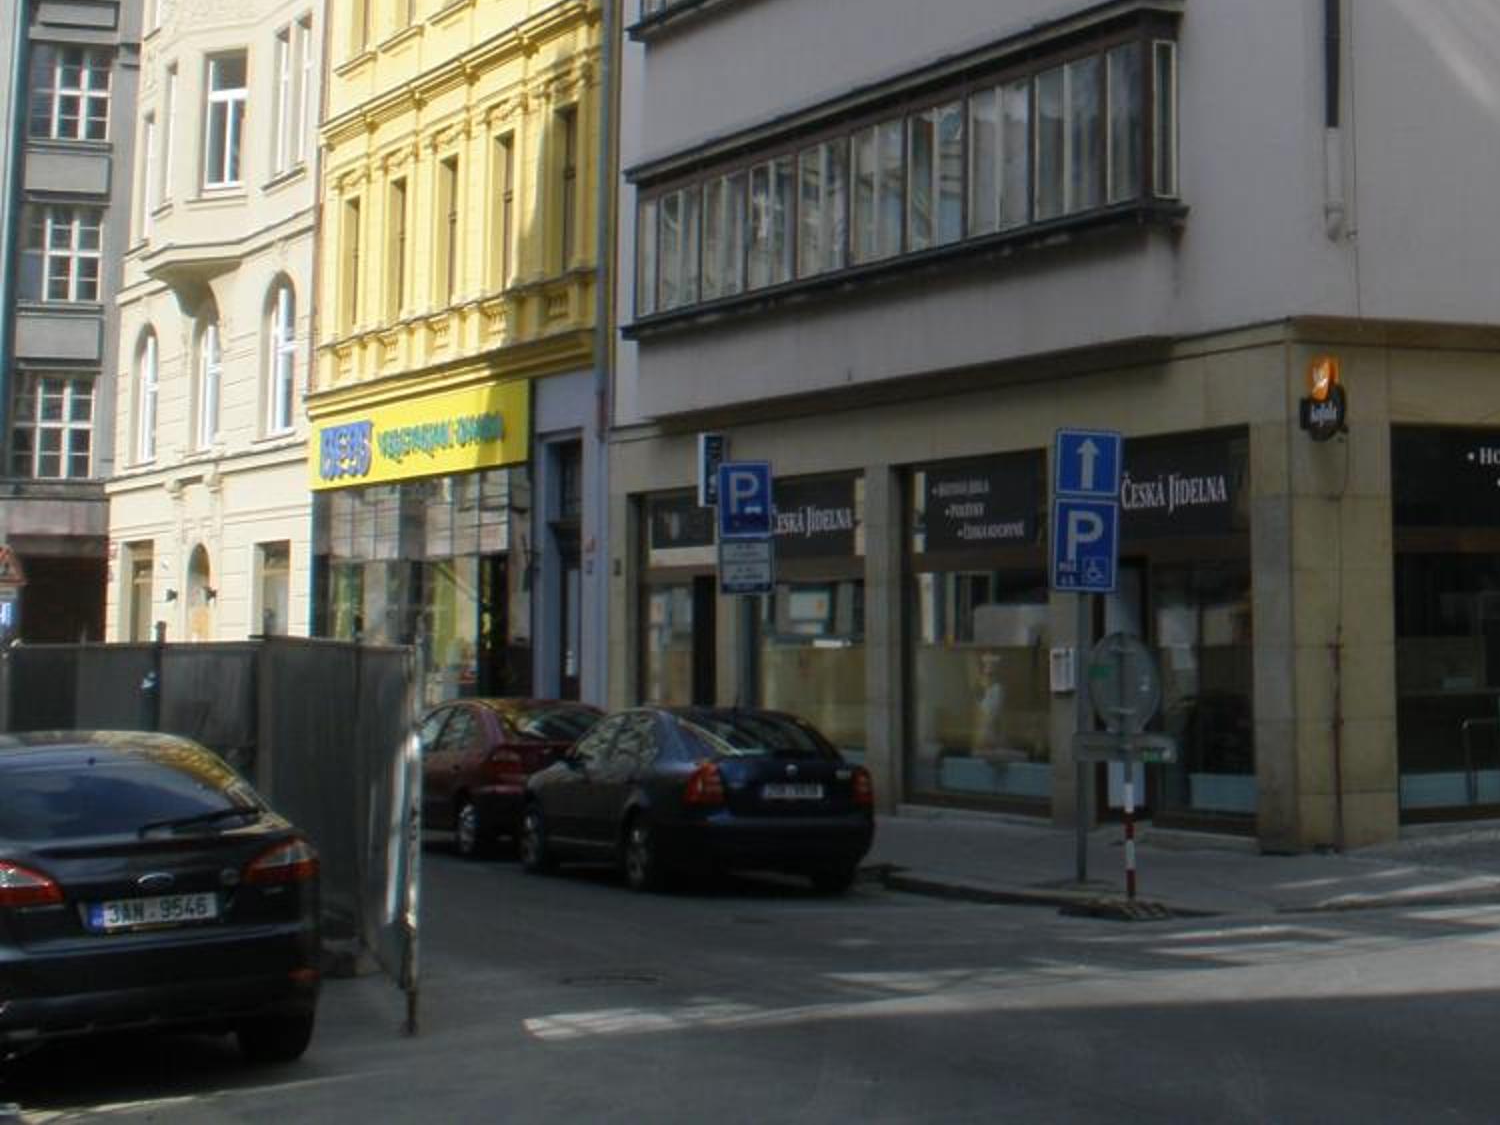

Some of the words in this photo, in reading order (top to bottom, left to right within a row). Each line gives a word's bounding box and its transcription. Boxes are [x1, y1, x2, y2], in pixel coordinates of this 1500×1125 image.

[729, 472, 760, 514] P
[1120, 470, 1166, 510] ČESKÁ
[1168, 472, 1227, 513] JÍDELNA
[805, 504, 853, 538] JÍDELNA
[1067, 510, 1104, 572] P
